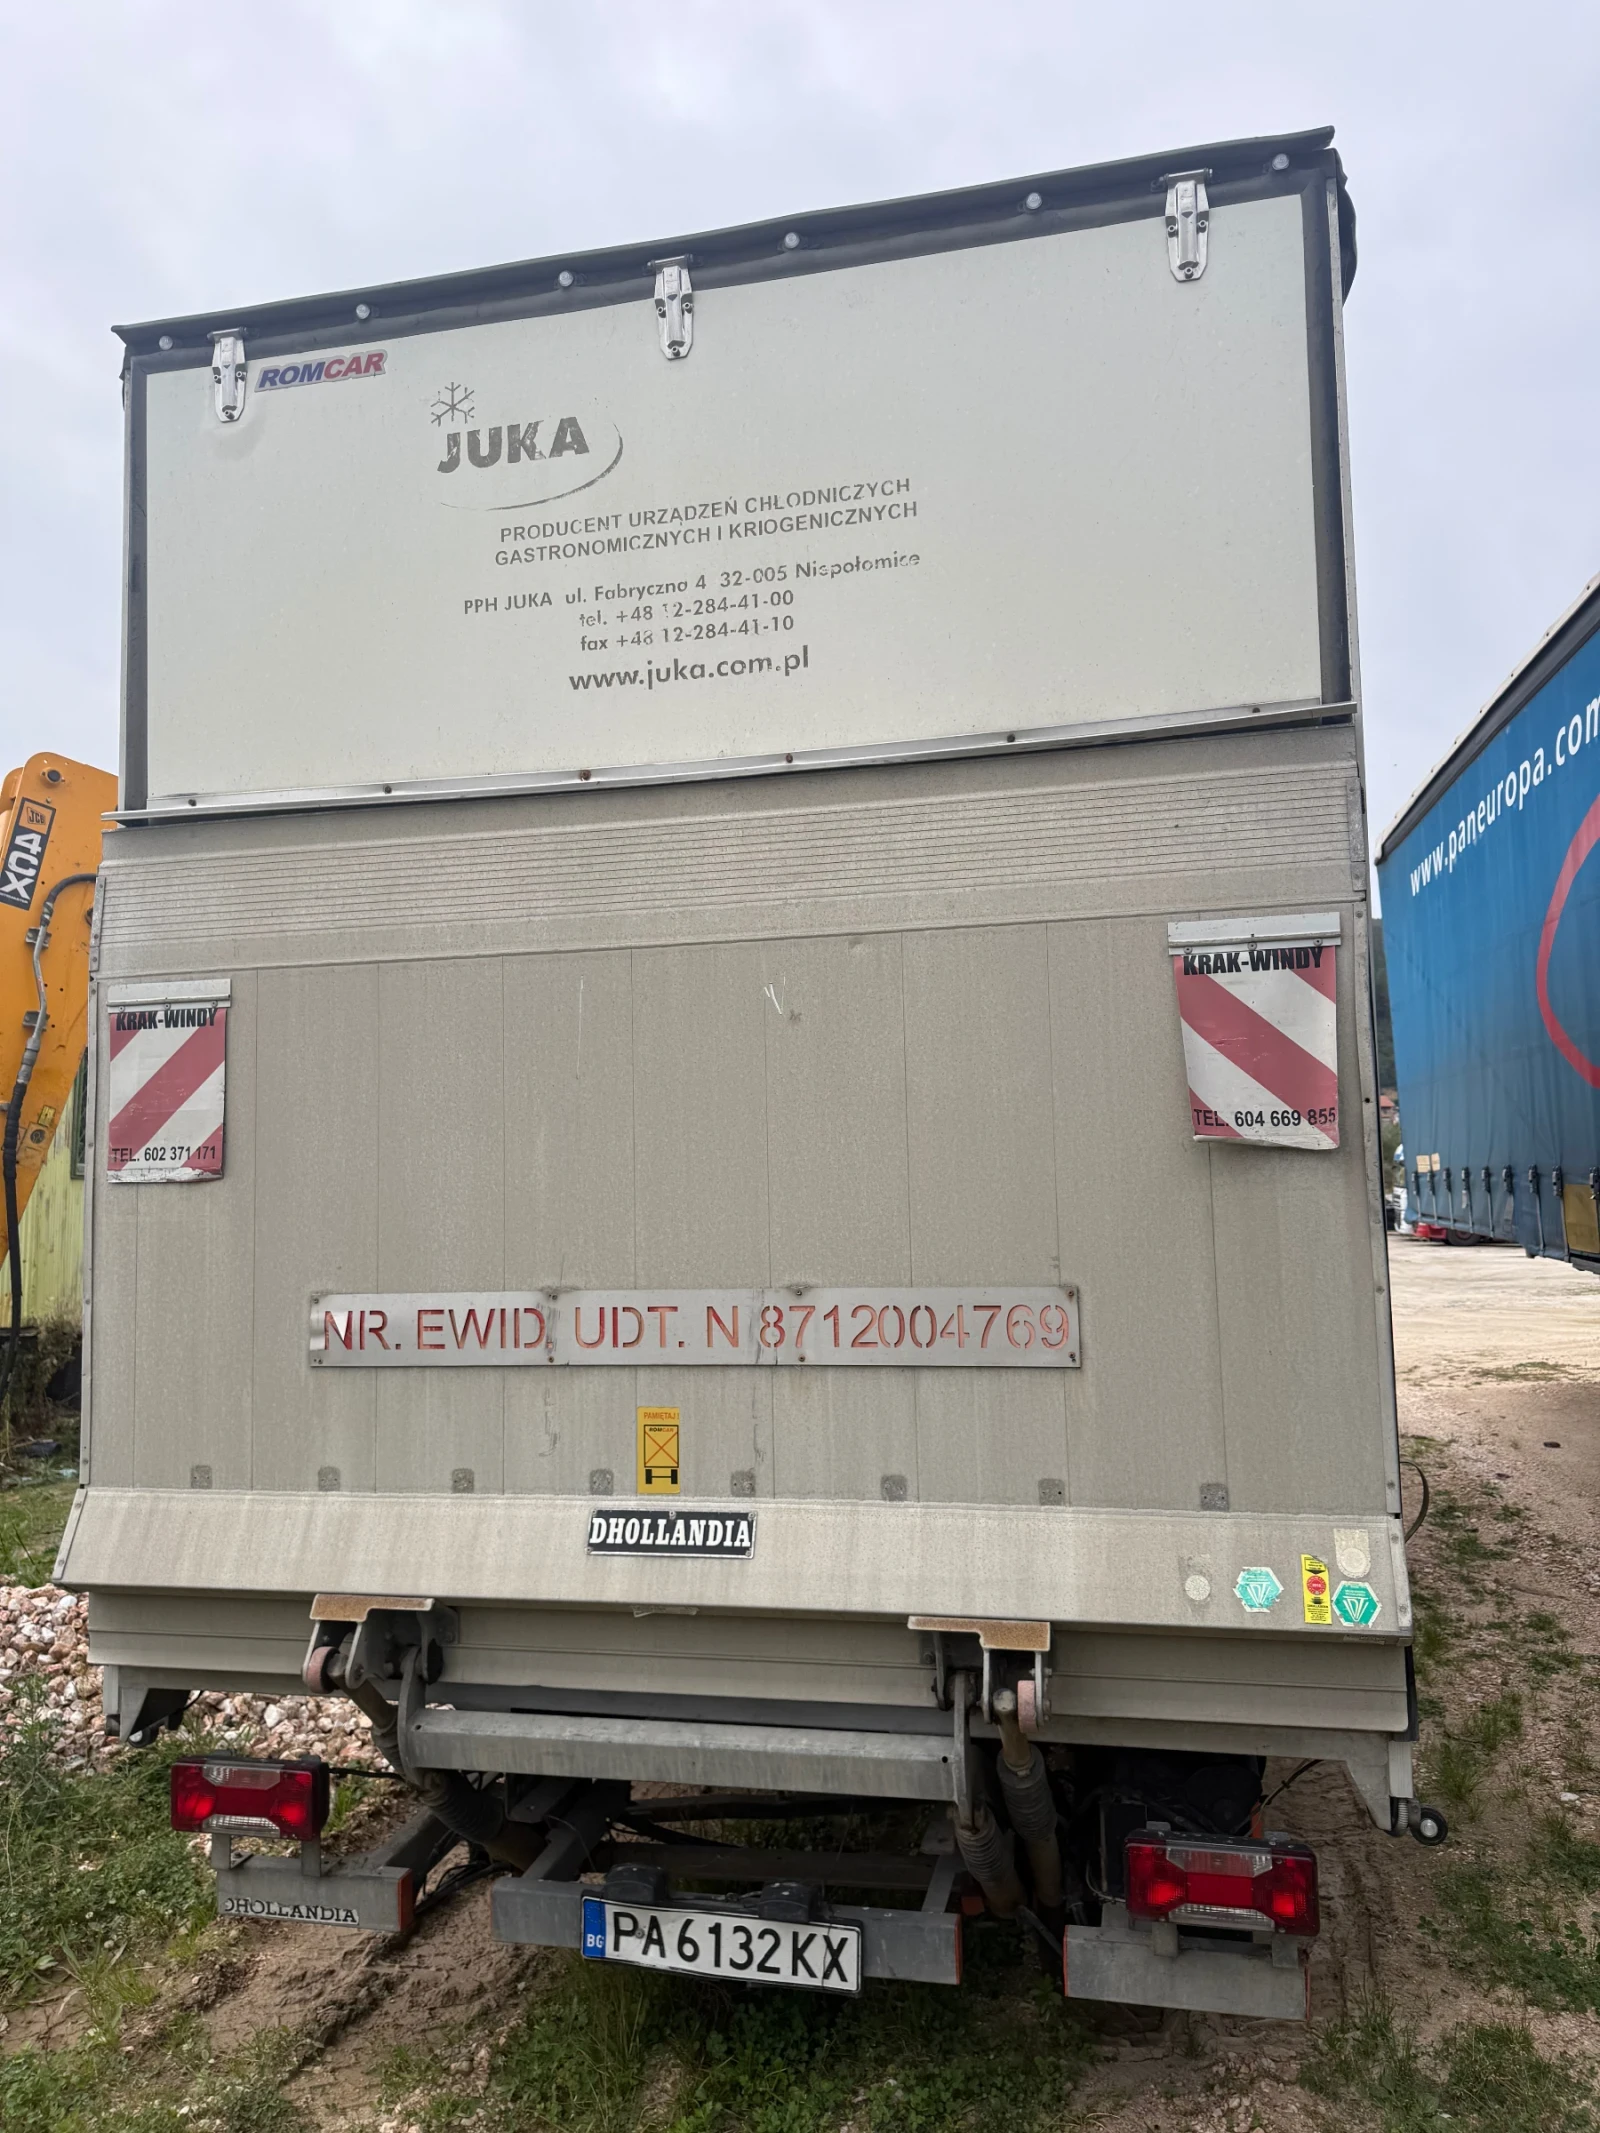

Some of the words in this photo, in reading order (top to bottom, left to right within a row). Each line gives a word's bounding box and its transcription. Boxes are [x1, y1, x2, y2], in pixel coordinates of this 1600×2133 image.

[259, 353, 385, 389] ROMCAR
[437, 417, 590, 474] JUKA
[500, 513, 622, 543] PRODUCENT
[630, 496, 739, 531] URZĄDZEŃ
[745, 477, 911, 514] CHŁODNICZYCH
[495, 525, 711, 566] GASTRONOMICZNYCH
[717, 525, 723, 541] I
[729, 500, 918, 539] KRIOGENICZNYCH
[463, 597, 498, 615] PPH
[504, 591, 553, 612] JUKA
[565, 586, 588, 605] ul.
[595, 577, 689, 606] Fabryczna
[695, 573, 707, 591] 4
[720, 565, 788, 590] 32-005
[579, 610, 608, 628] tel.
[615, 605, 654, 624] +48
[580, 634, 609, 652] fax
[615, 629, 654, 649] +48
[663, 614, 796, 643] 12-284-41-10
[569, 644, 810, 691] www.juka.com.pl
[1409, 696, 1600, 898] www.paneuropa.com
[0, 832, 42, 900] 4CX
[1183, 946, 1323, 976] KRAK-WINDY
[116, 1007, 218, 1031] KRAK-WINDY
[1194, 1108, 1230, 1127] TEL.
[1235, 1110, 1266, 1127] 604
[1270, 1109, 1301, 1127] 669
[1307, 1107, 1336, 1126] 855
[112, 1148, 140, 1163] TEL.
[144, 1146, 166, 1161] 602
[170, 1146, 190, 1161] 371
[196, 1145, 216, 1160] 171
[322, 1308, 402, 1351] NR.
[417, 1307, 553, 1351] EWID.
[574, 1305, 684, 1349] UDT.
[705, 1305, 740, 1349] N
[759, 1303, 1069, 1351] 8712004769
[589, 1516, 751, 1548] DHOLLANDIA
[586, 1933, 605, 1949] BG
[613, 1911, 849, 1984] PA6132KX
